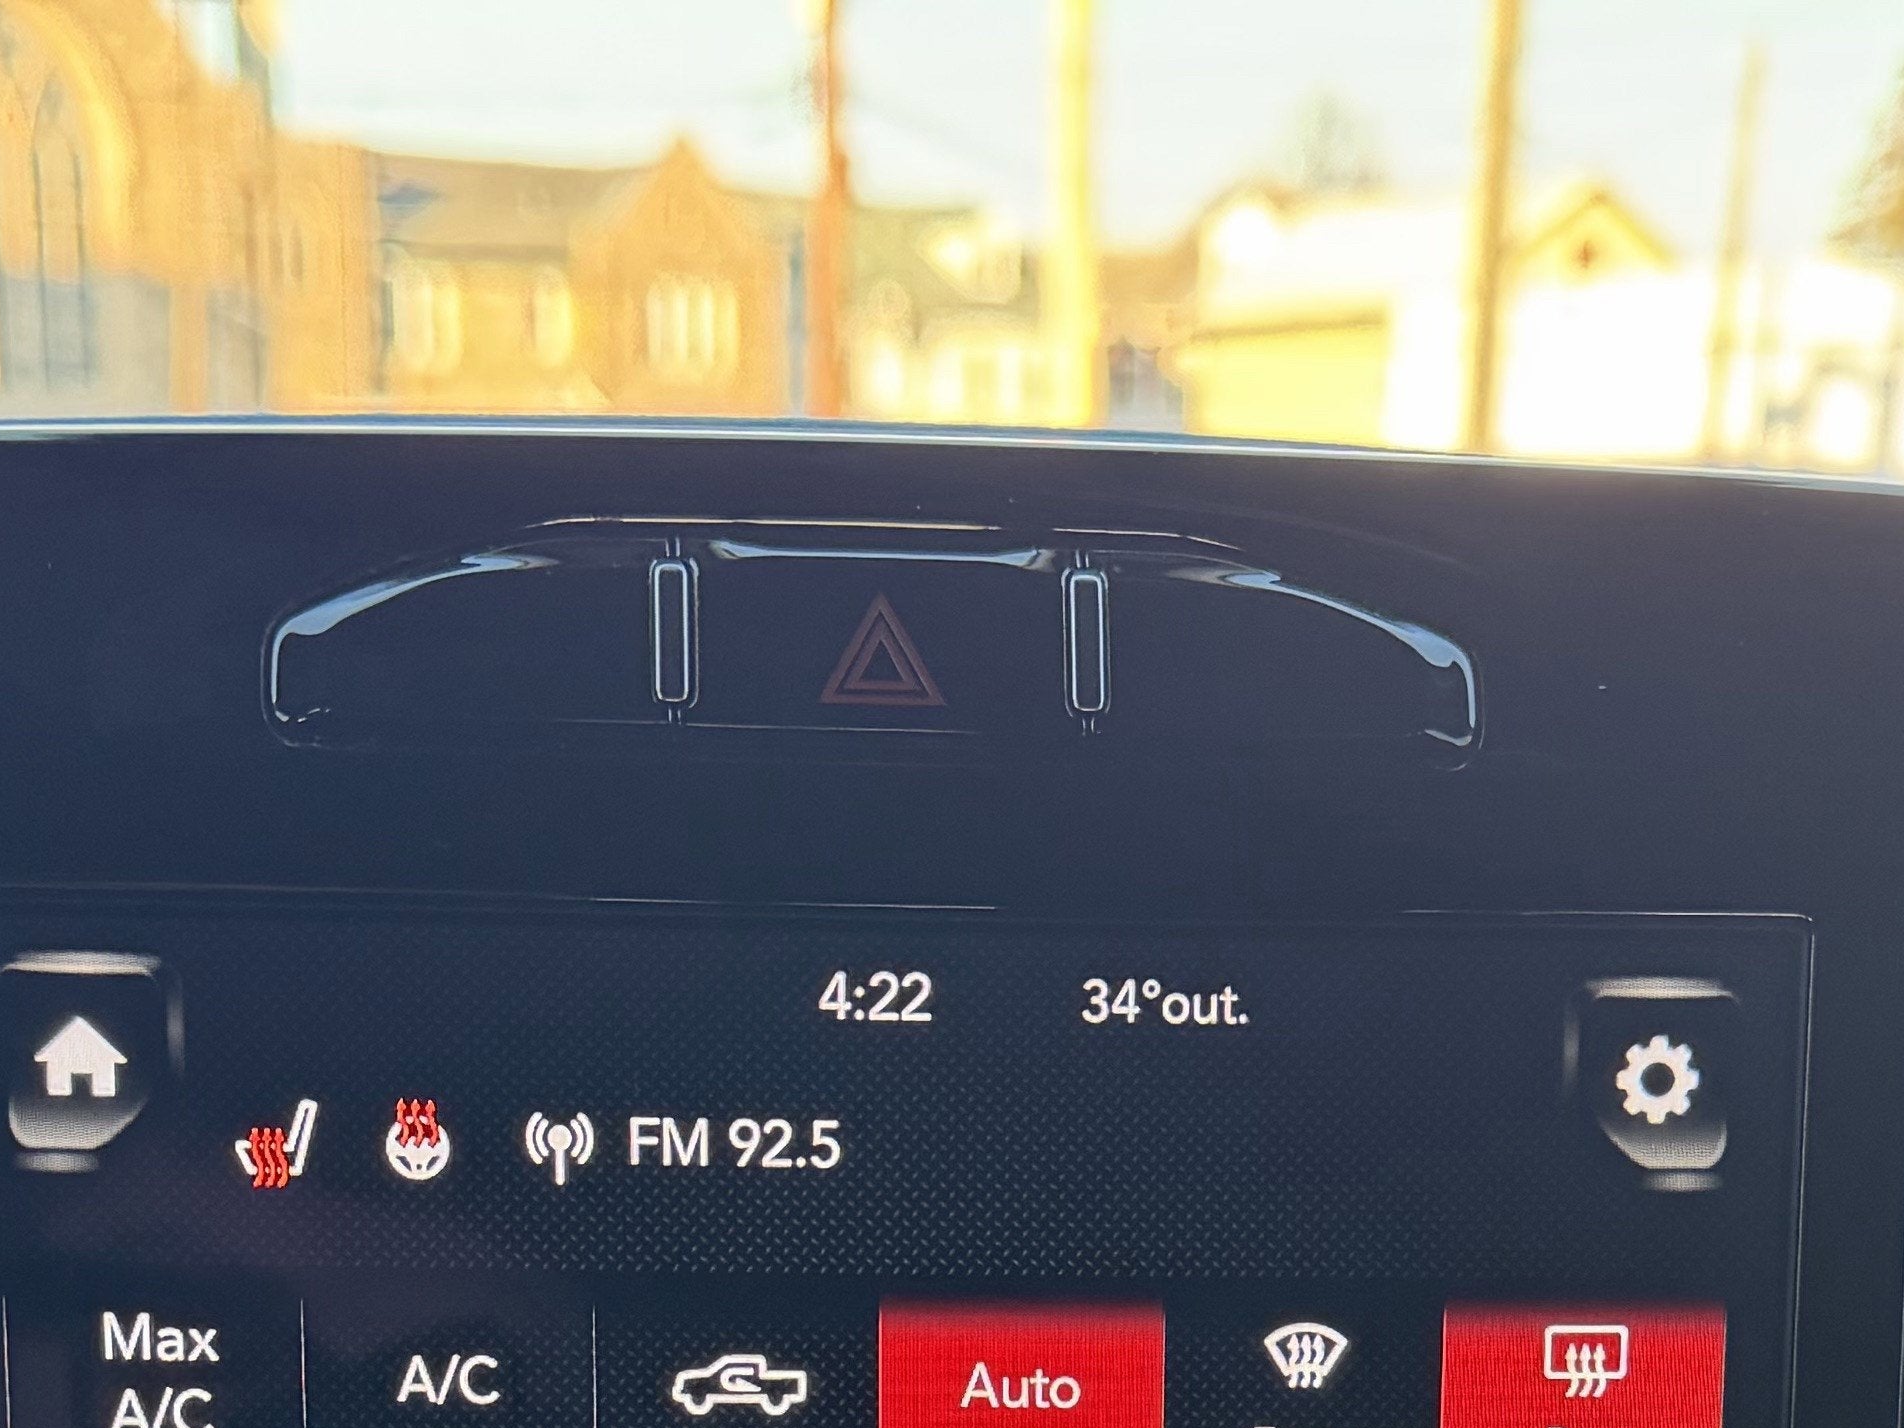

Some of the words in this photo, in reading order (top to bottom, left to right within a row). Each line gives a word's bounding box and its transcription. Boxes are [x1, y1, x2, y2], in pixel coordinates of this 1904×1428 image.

[818, 970, 932, 1022] 4:22
[629, 1116, 709, 1167] FM
[728, 1117, 841, 1169] 92.5
[102, 1311, 220, 1362] Max
[396, 1353, 501, 1406] A/C
[960, 1361, 1081, 1409] Auto
